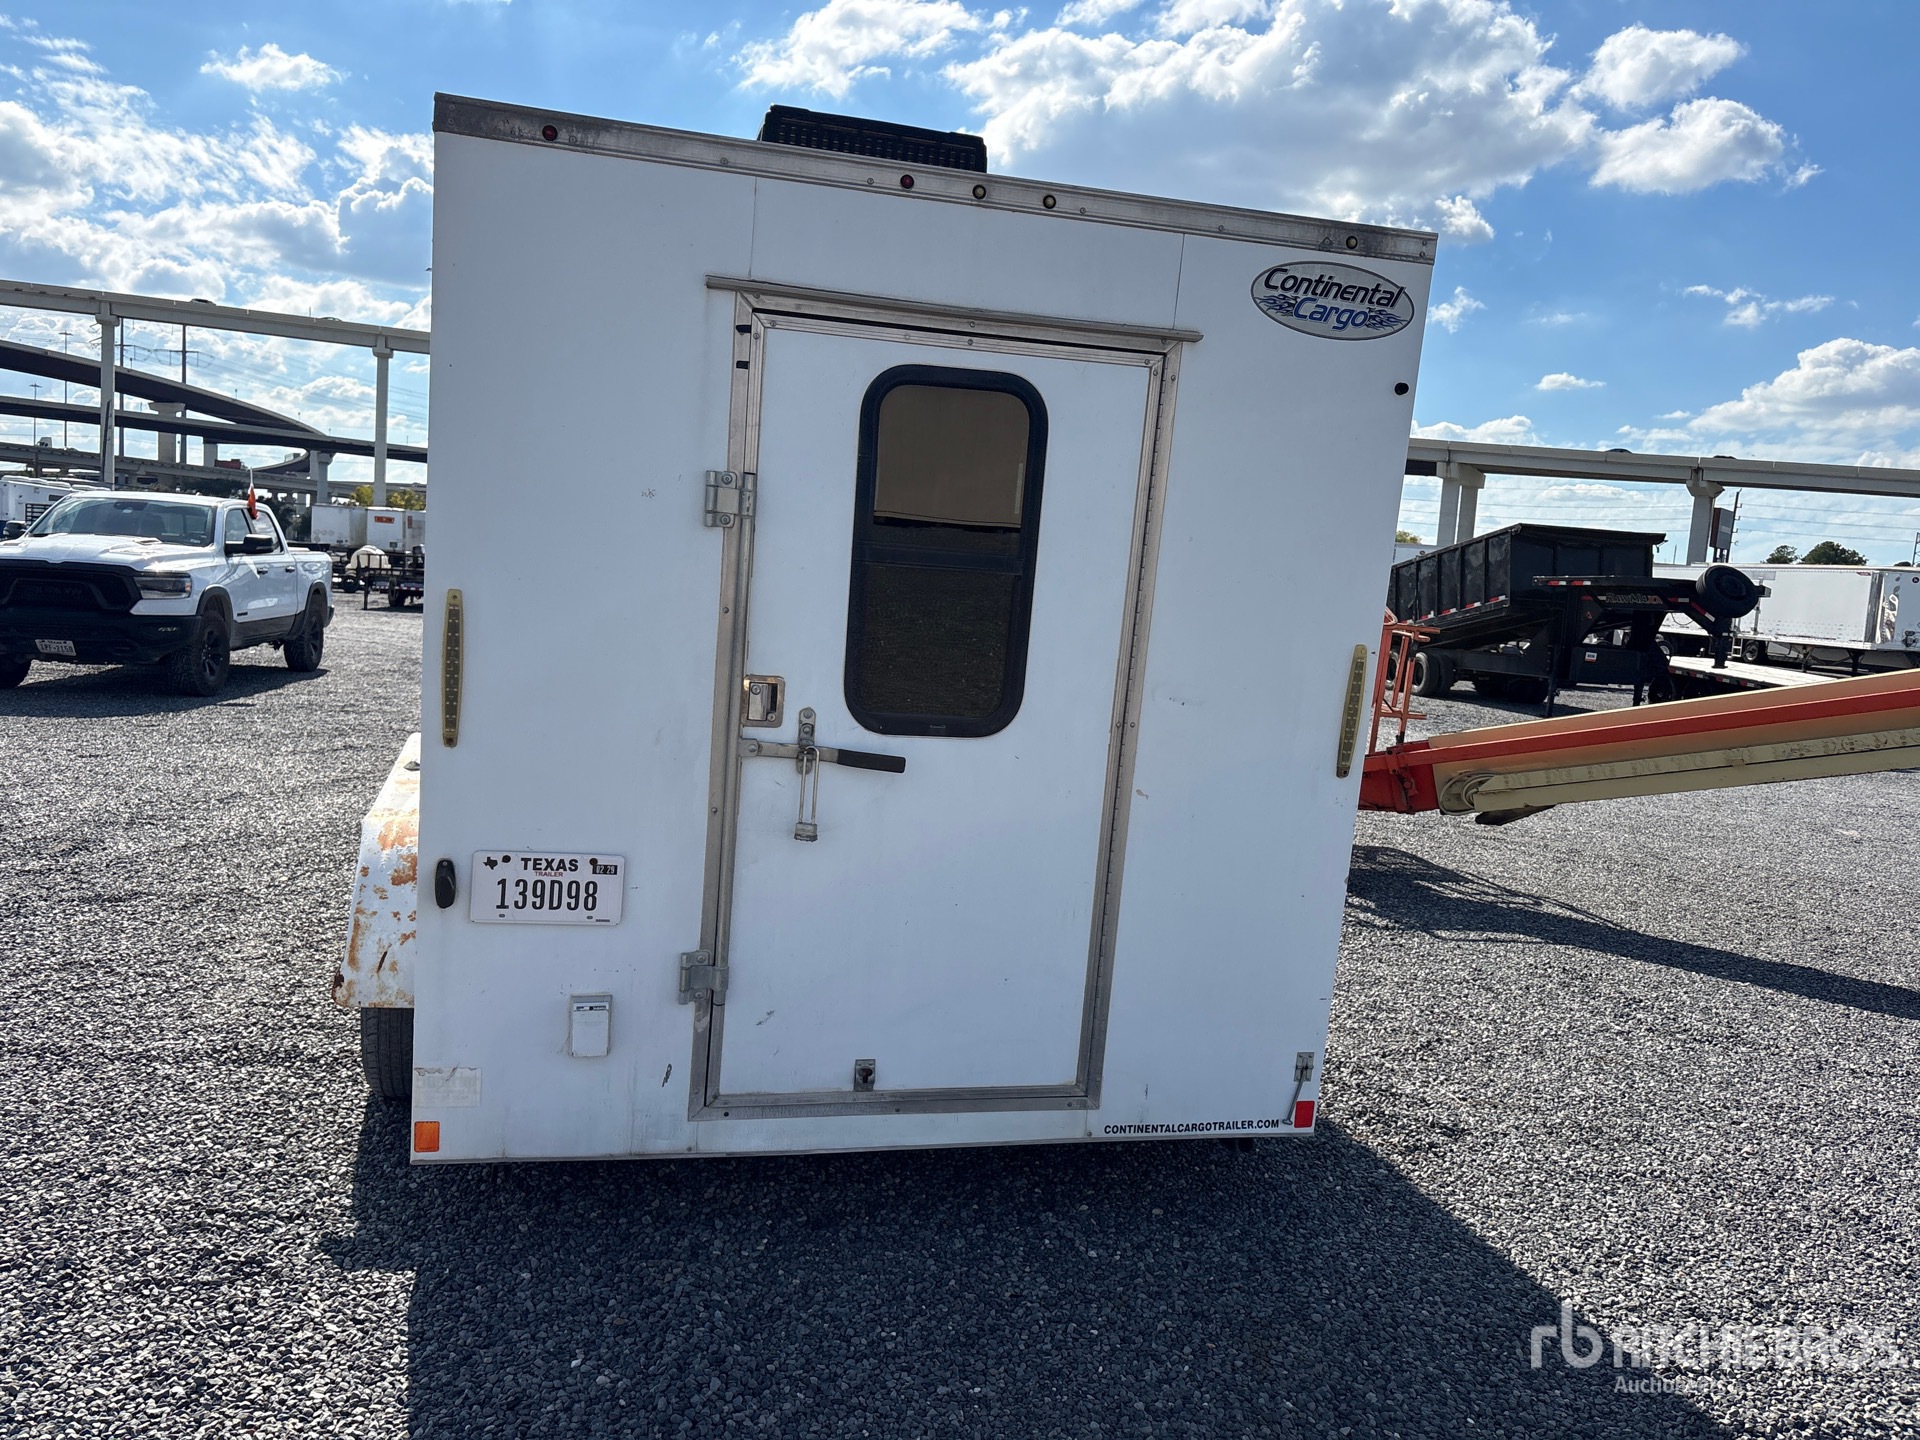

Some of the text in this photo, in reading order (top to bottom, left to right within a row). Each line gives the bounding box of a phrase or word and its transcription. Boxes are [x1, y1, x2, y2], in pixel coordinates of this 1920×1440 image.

[1264, 268, 1405, 308] Continental
[1293, 297, 1369, 331] Cargo
[520, 857, 579, 872] TEXAS
[496, 878, 598, 911] 139D98
[1104, 1119, 1279, 1135] CONTINENTALCARGOTRAILER.COM
